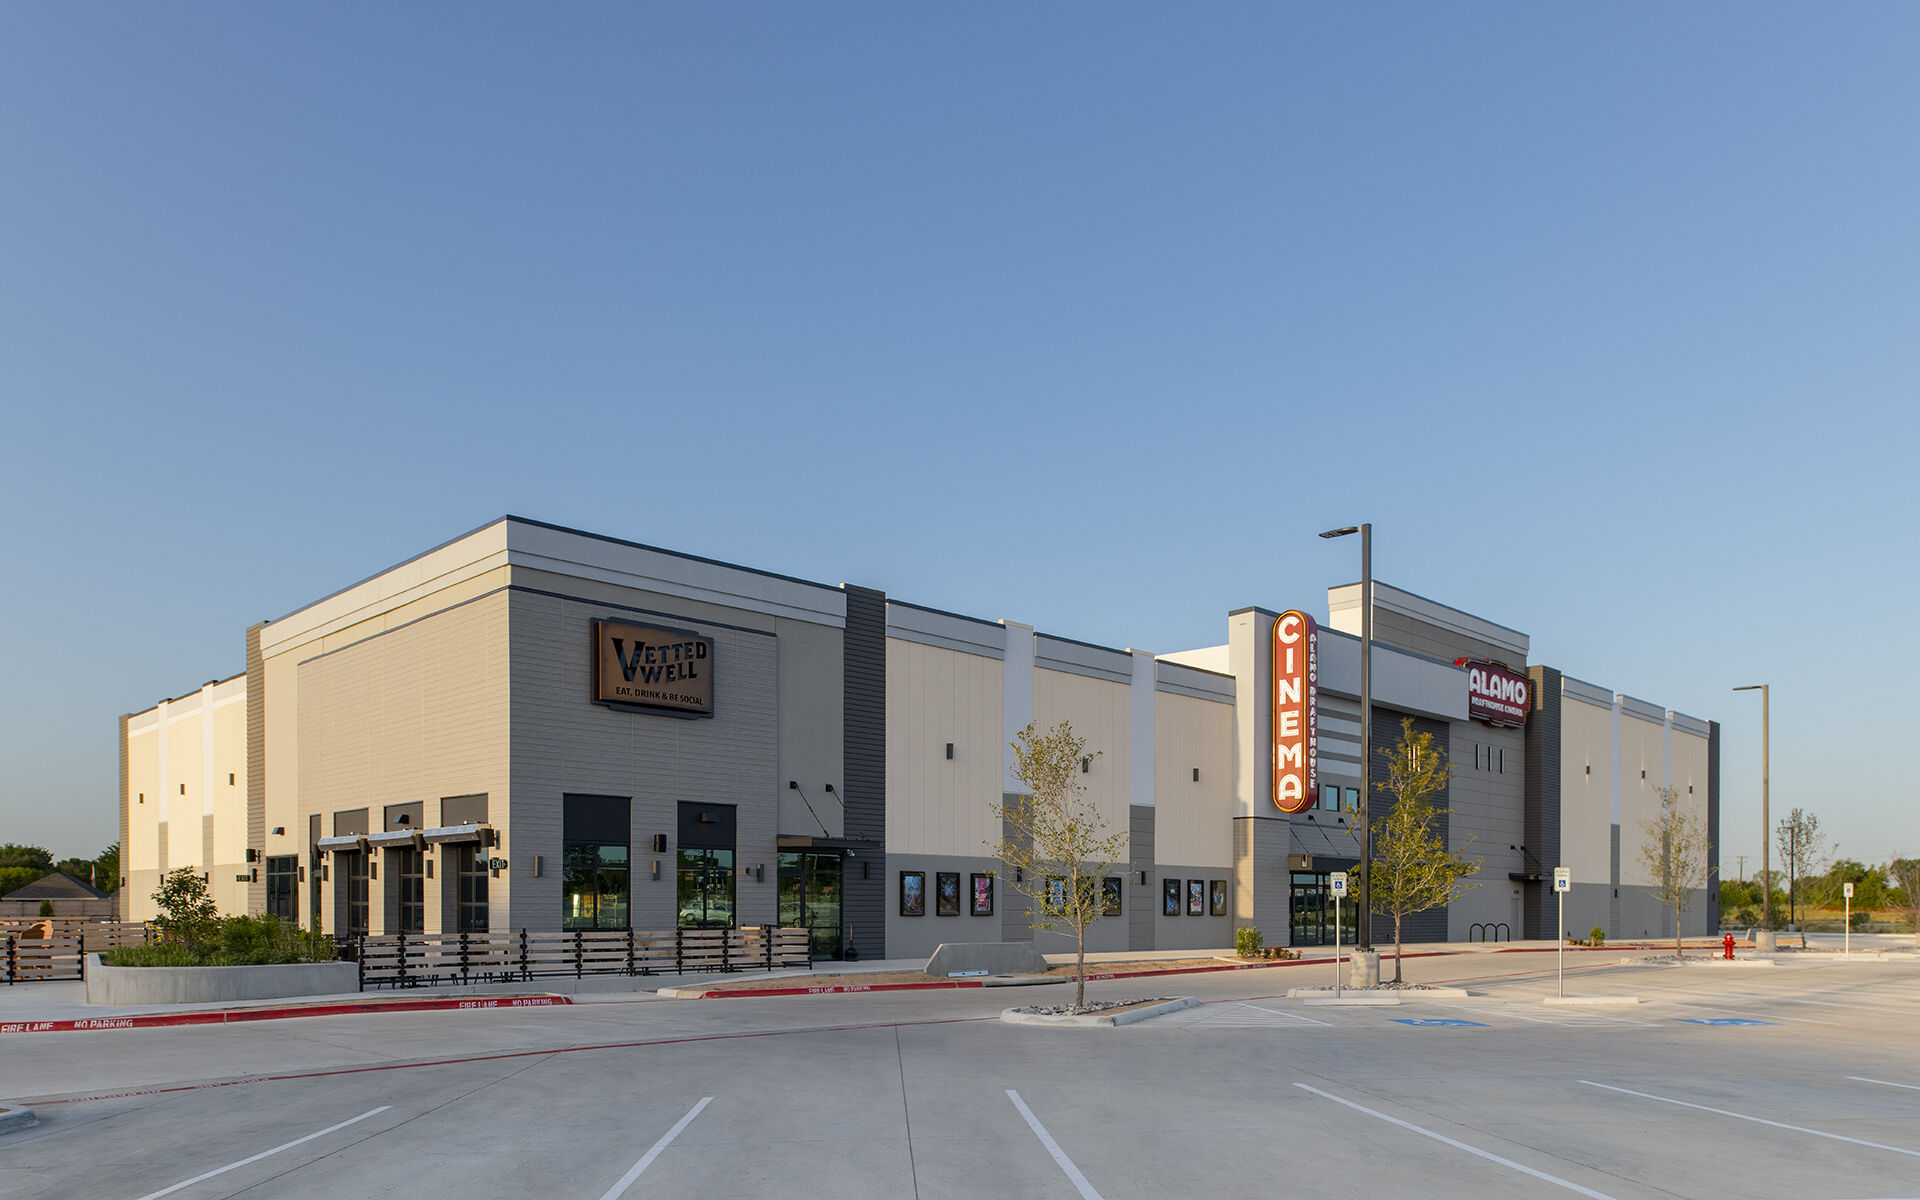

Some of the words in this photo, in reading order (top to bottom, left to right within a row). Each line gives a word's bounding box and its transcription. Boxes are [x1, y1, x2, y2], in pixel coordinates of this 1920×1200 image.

[611, 637, 707, 682] VETTED
[639, 661, 698, 684] WELL
[1309, 633, 1317, 682] ALAMO
[616, 686, 633, 697] EAT,
[634, 688, 660, 699] DRINK
[661, 692, 668, 701] &
[669, 693, 679, 702] BE
[679, 694, 704, 706] SOCIAL
[1469, 668, 1527, 705] ALAMO
[1278, 616, 1303, 801] CINEMA
[1309, 686, 1317, 789] DRAFTHOUSE
[459, 1001, 477, 1009] FIRE
[512, 999, 522, 1008] NO
[523, 998, 553, 1007] PARKING
[1, 1023, 24, 1033] FIRE
[25, 1022, 54, 1033] LANE
[74, 1020, 88, 1029] NO
[89, 1019, 134, 1029] PARKING
